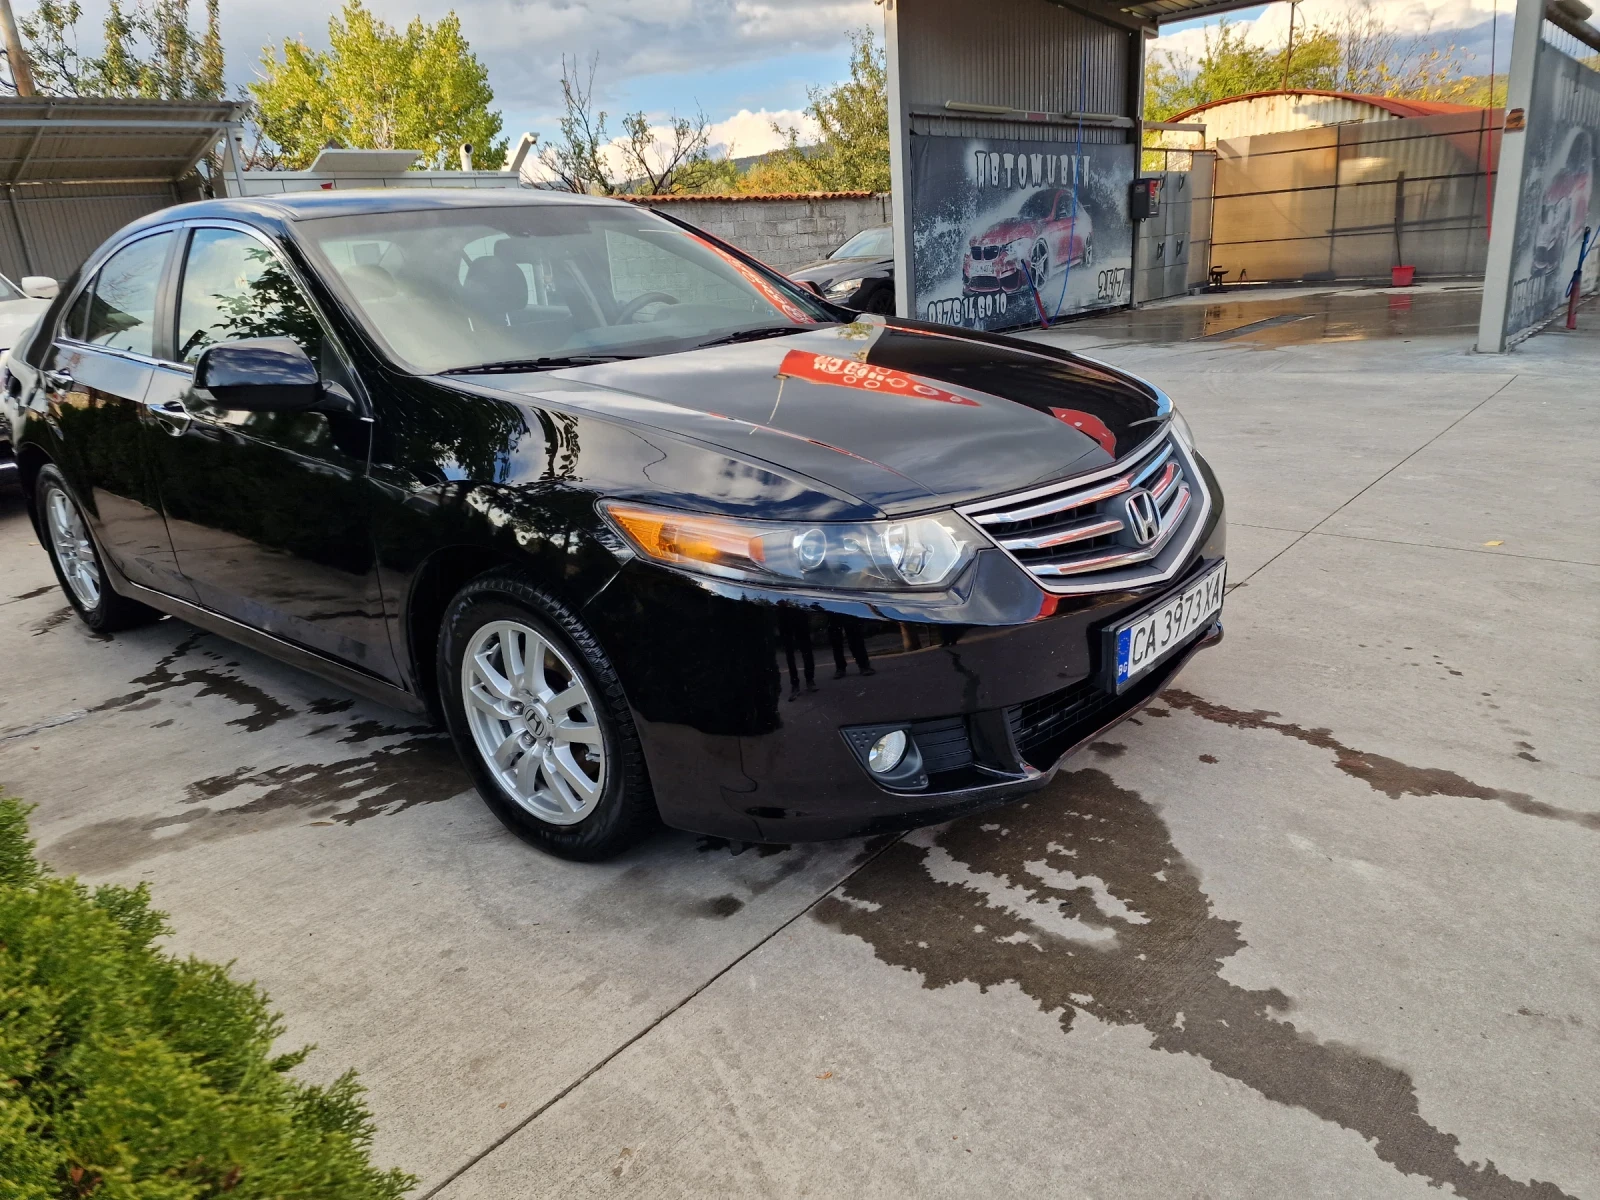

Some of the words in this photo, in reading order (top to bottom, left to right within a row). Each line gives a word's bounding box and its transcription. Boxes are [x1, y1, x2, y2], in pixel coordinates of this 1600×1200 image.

[1132, 619, 1157, 666] CA
[1160, 588, 1201, 647] 3973
[1203, 572, 1221, 617] XA
[1118, 661, 1129, 676] BG
